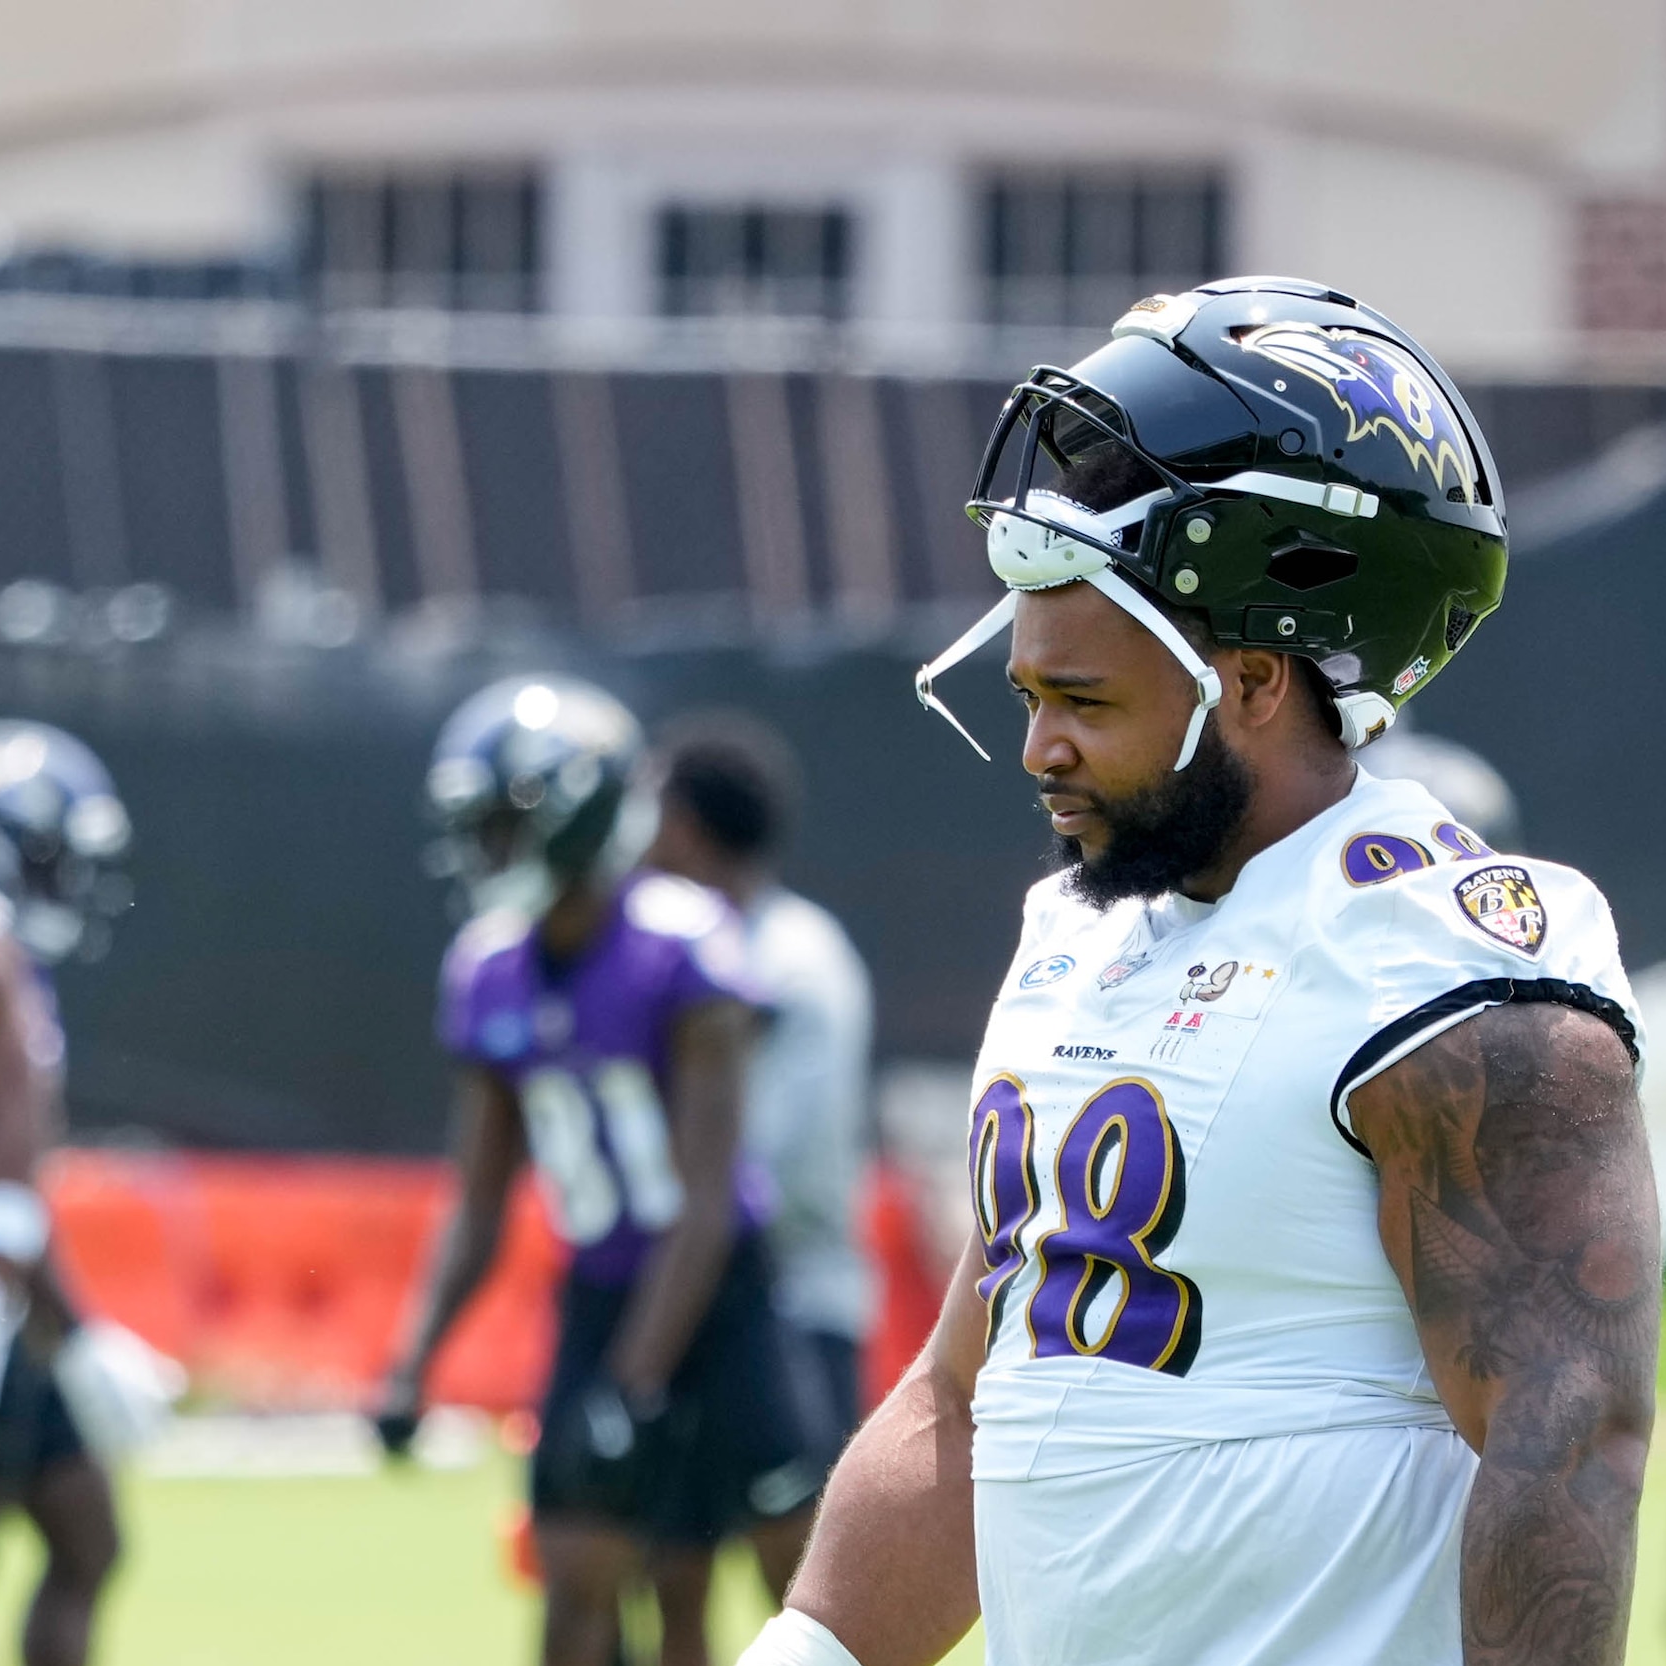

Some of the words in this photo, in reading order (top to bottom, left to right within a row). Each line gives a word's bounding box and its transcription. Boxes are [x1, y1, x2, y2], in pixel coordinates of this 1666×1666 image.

[1393, 372, 1434, 441] B
[1458, 868, 1525, 896] RAVENS
[1052, 1045, 1118, 1061] RAVENS
[967, 1070, 1203, 1379] 98
